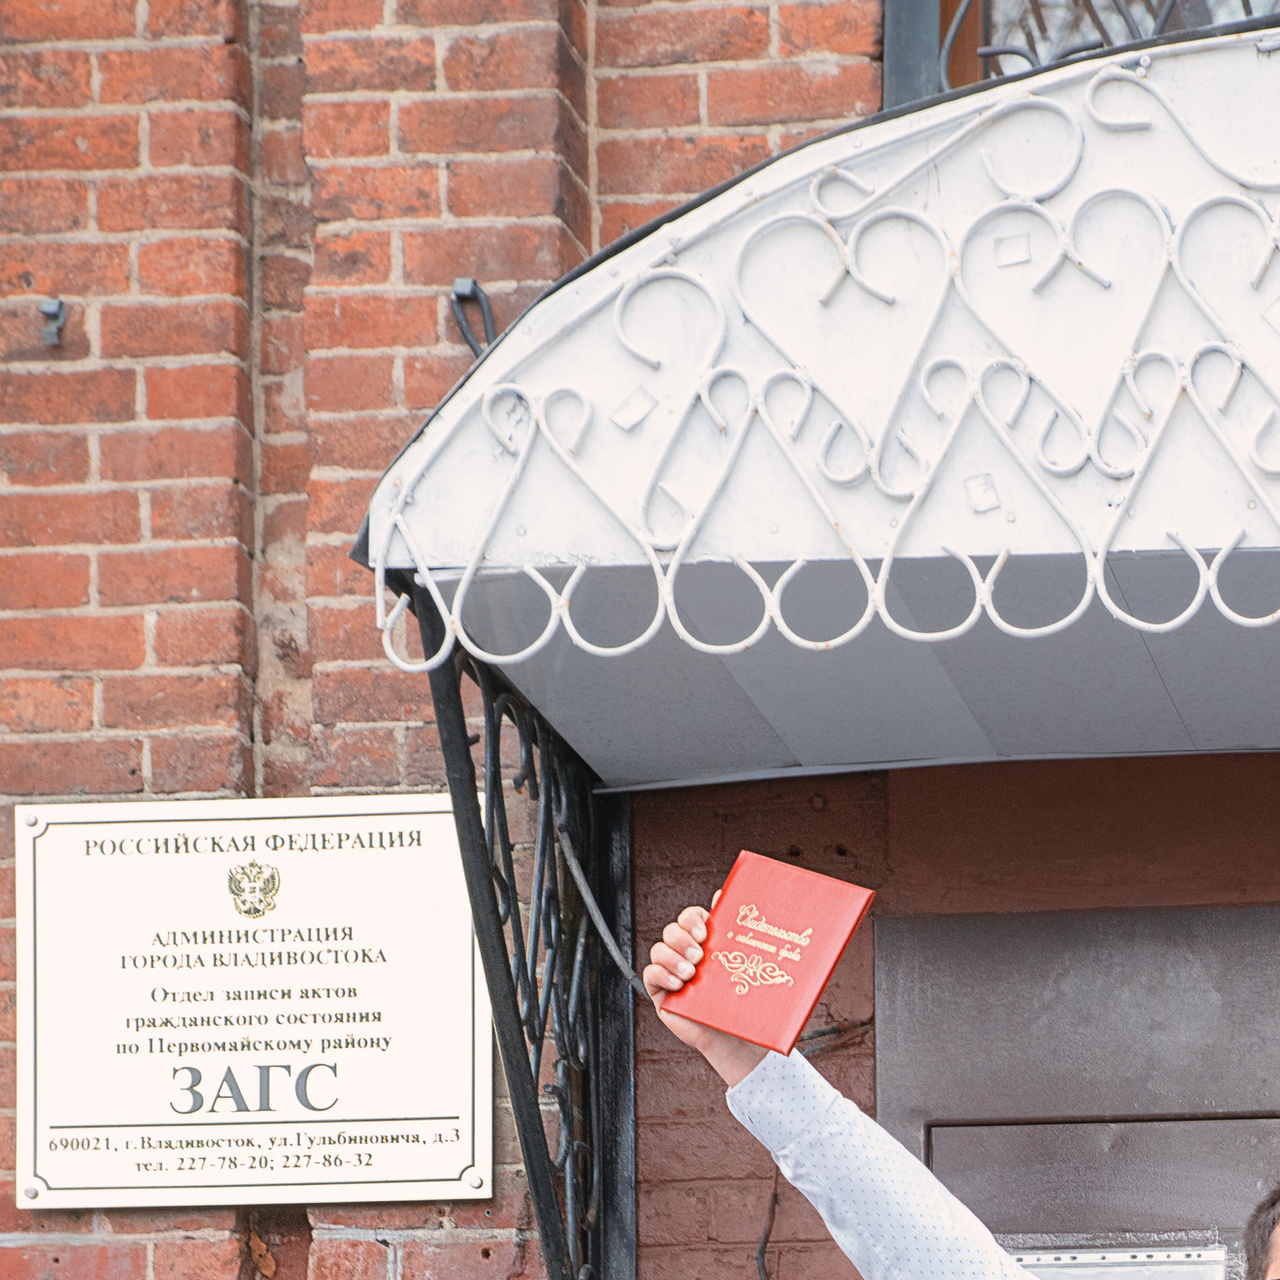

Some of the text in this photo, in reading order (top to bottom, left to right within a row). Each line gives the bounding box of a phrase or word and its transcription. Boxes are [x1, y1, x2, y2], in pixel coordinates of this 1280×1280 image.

[85, 830, 422, 856] РОССИЙСКАЯ ФЕДЕРАЦИЯ
[151, 925, 354, 948] АДМИНИСТРАЦИЯ
[121, 948, 387, 970] ГОРОДА ВЛАДИВОСТОКА
[150, 986, 358, 1004] Отдел записи актов
[125, 1011, 382, 1033] гражданского состояния
[116, 1033, 392, 1057] по Первомайскому району
[169, 1062, 339, 1115] ЗАГС
[48, 1137, 118, 1153] 690021,
[135, 1152, 373, 1173] тел. 227-78-20; 227-86-32
